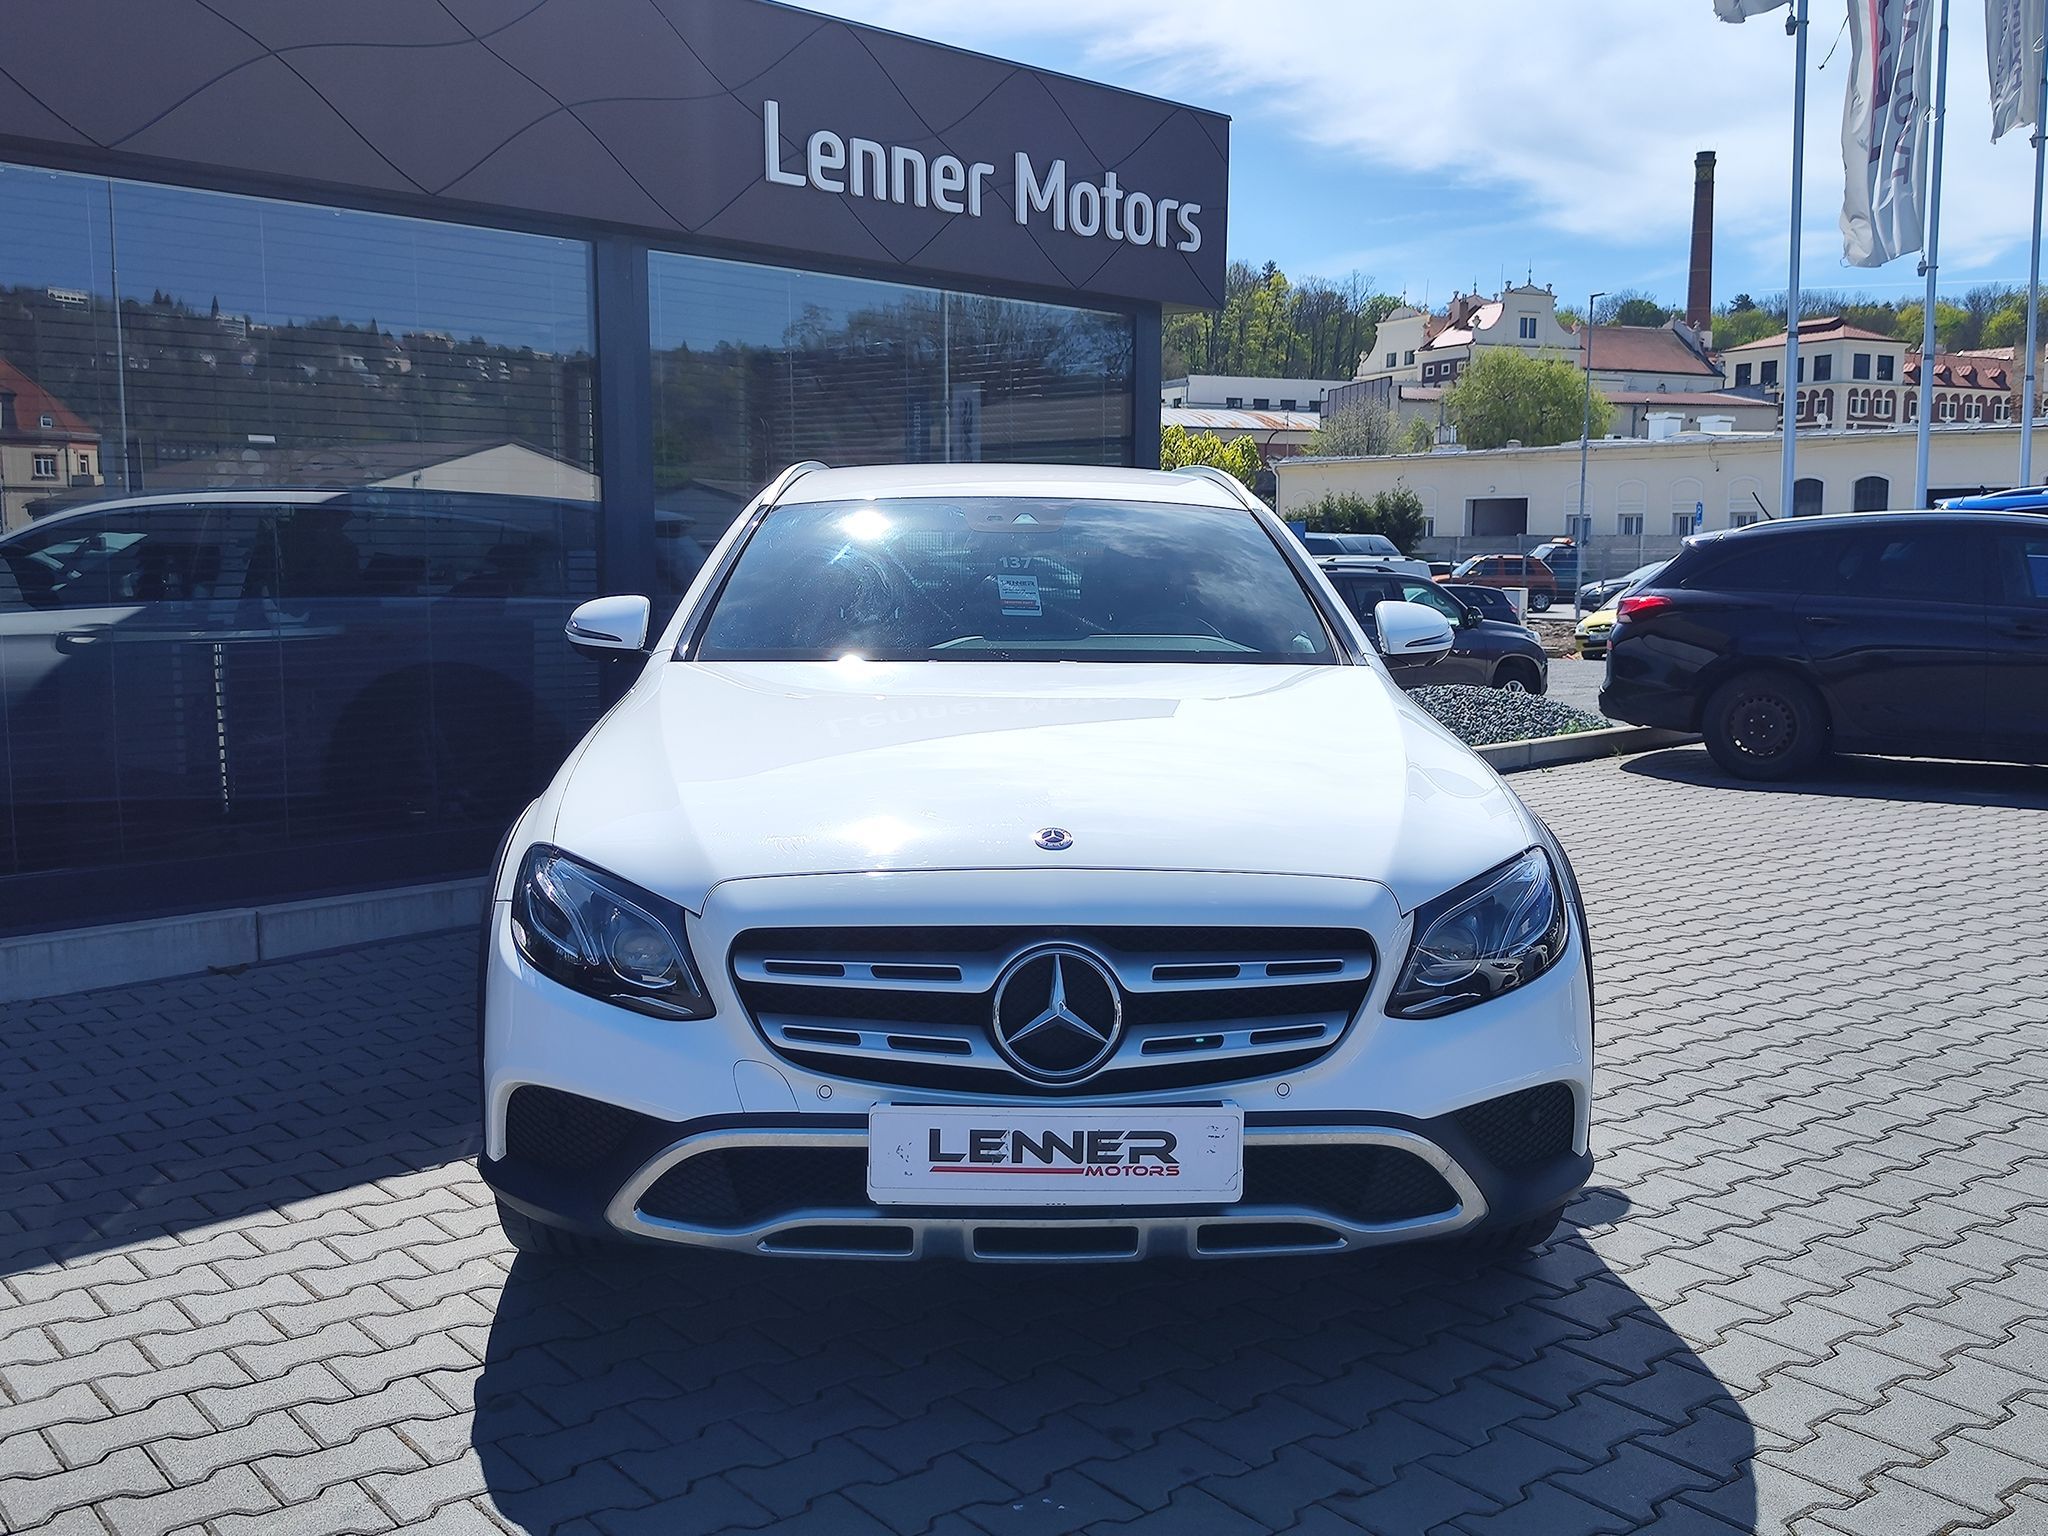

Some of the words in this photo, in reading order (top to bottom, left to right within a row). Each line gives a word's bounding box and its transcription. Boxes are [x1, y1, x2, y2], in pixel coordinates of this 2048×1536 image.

[764, 100, 995, 217] Lenner
[1014, 151, 1202, 253] Motors
[999, 556, 1033, 569] 137
[928, 1128, 1180, 1165] LENNER
[1084, 1165, 1180, 1177] MOTORS
